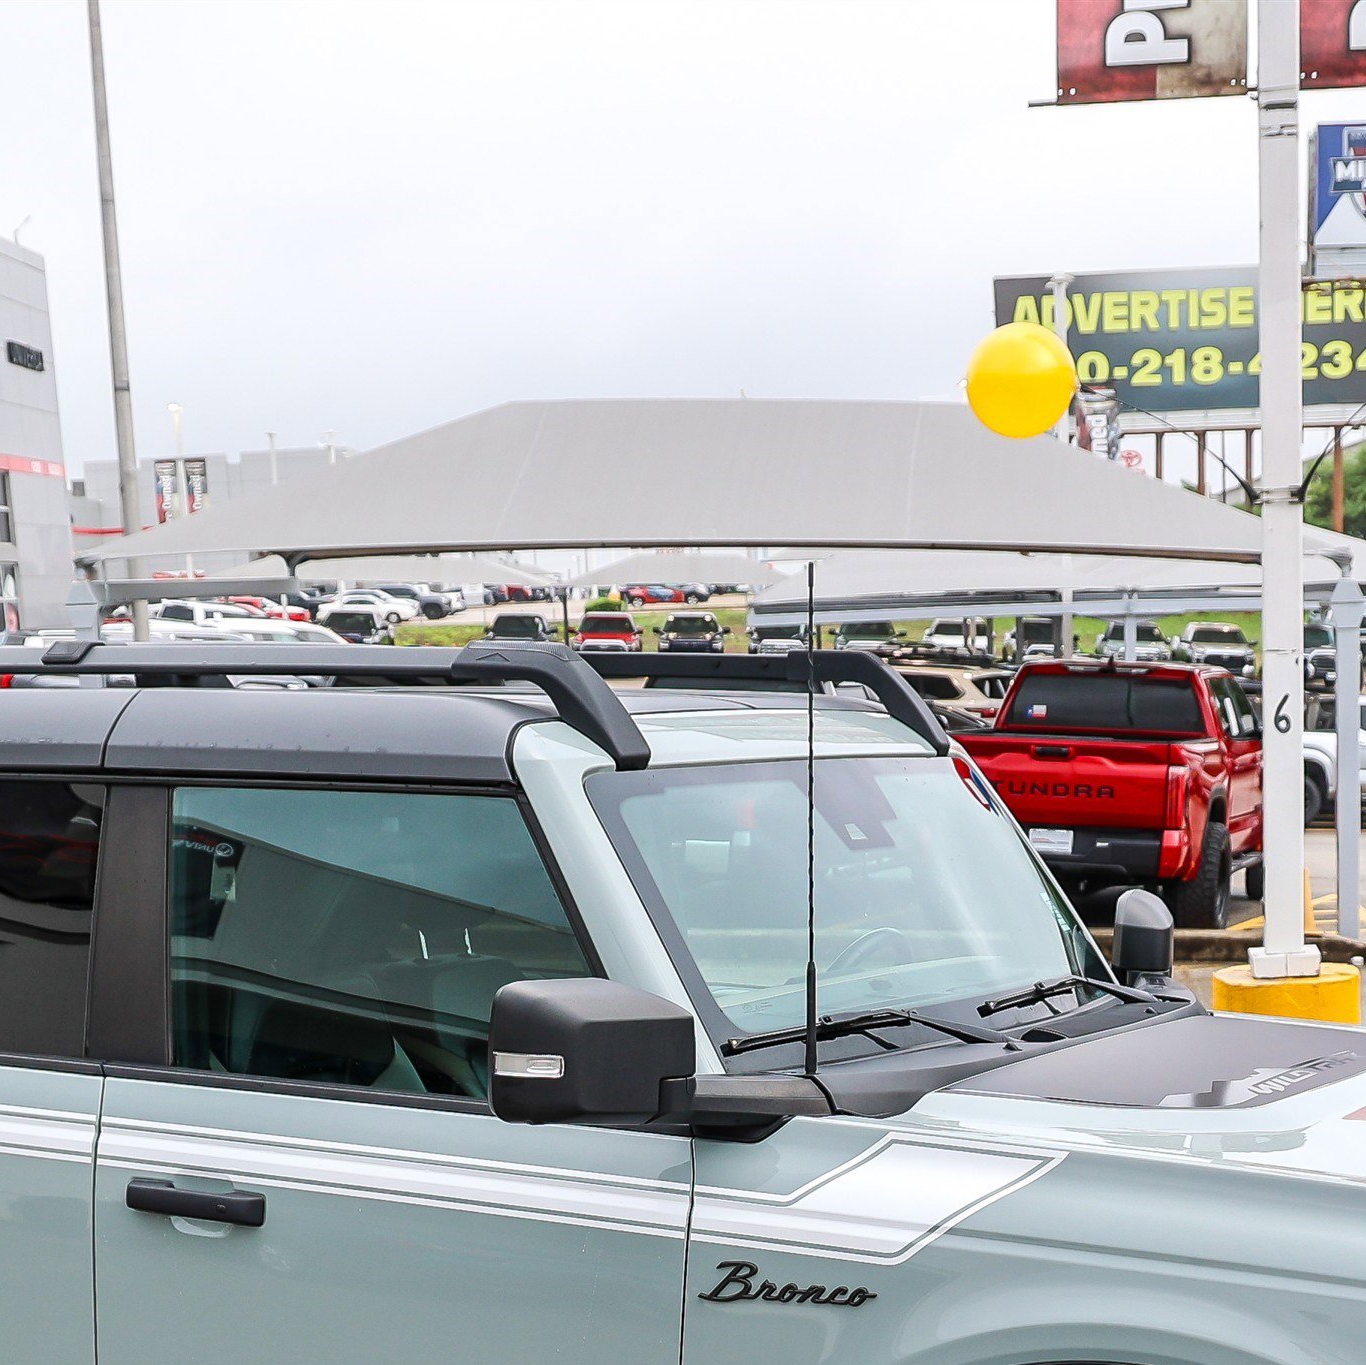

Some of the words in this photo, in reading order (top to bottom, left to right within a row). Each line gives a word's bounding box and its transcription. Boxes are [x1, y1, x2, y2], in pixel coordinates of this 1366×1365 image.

[1012, 286, 1256, 335] ADVERTISE
[1274, 694, 1292, 735] 6
[992, 781, 1115, 799] TUNDRA
[698, 1261, 877, 1307] Bronco
